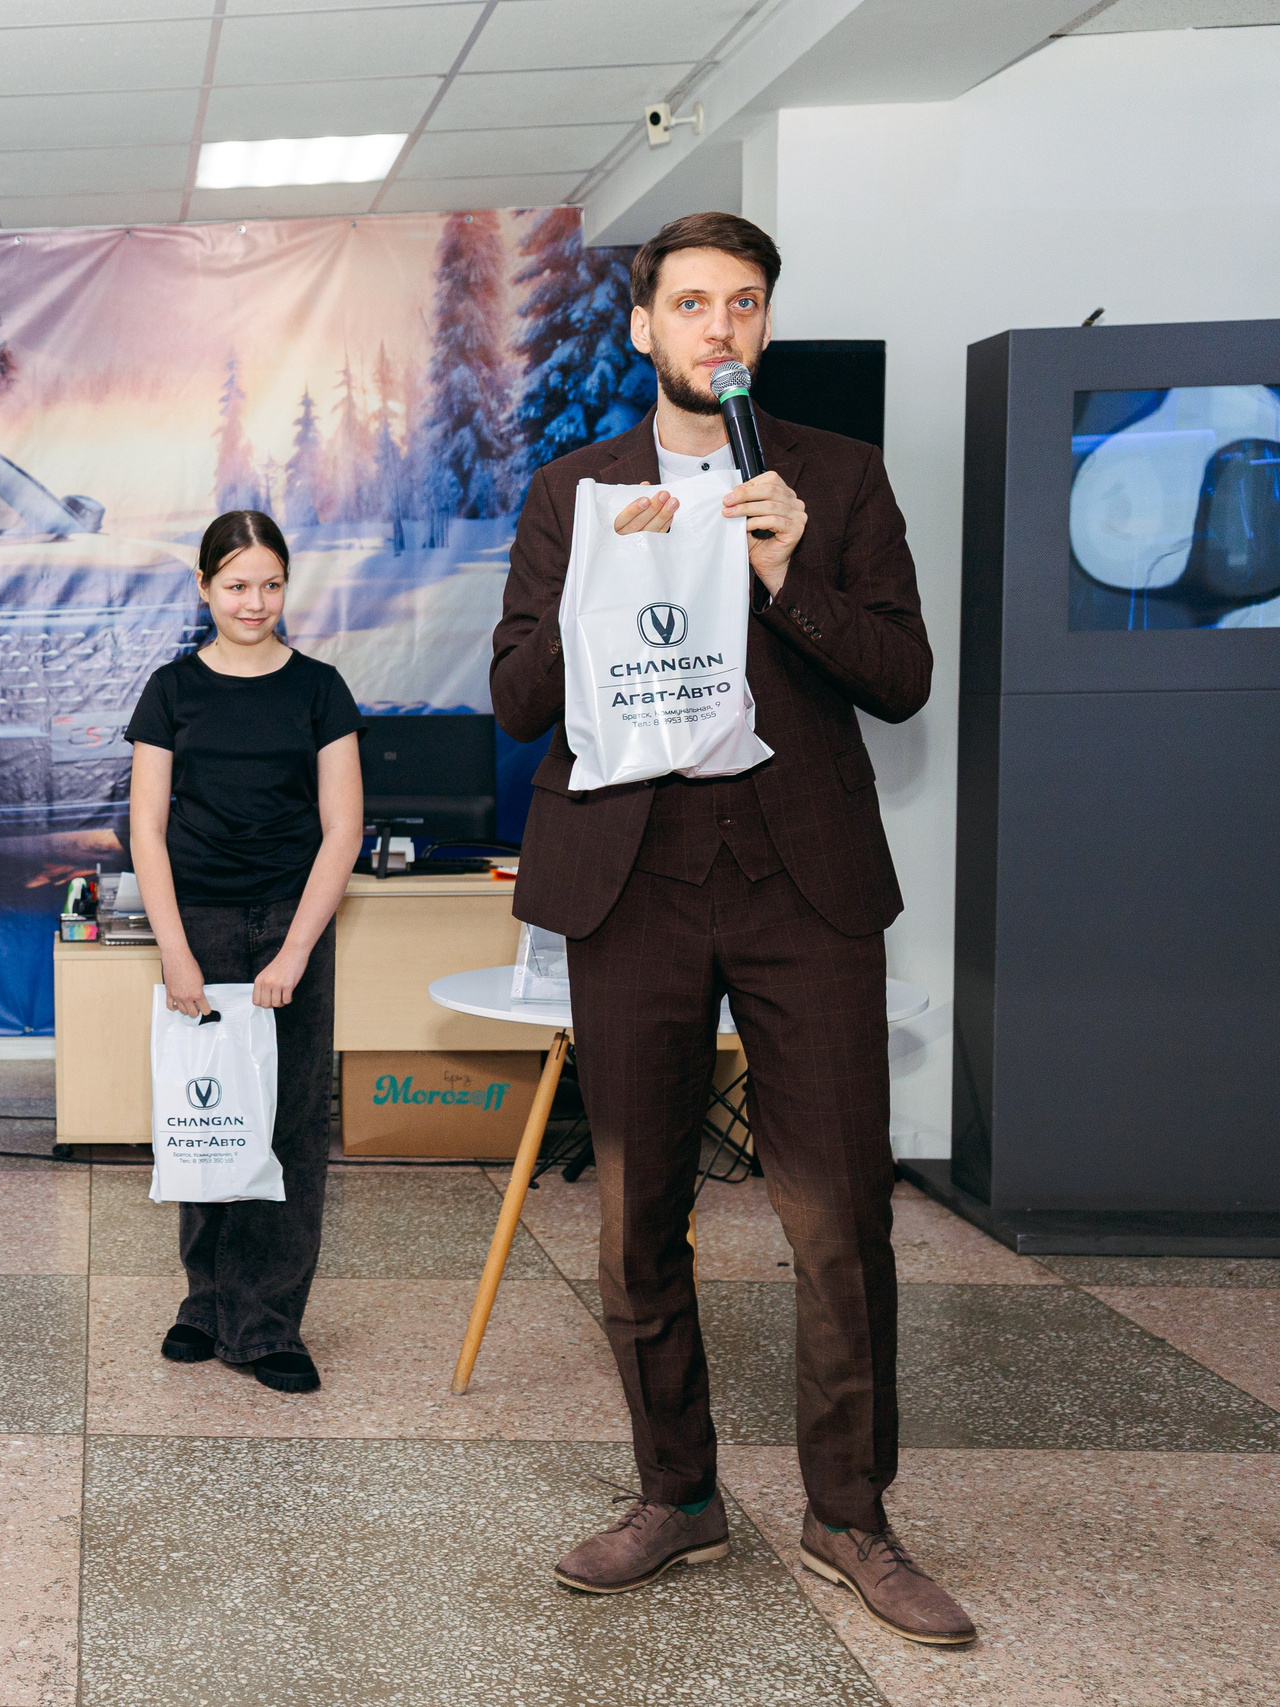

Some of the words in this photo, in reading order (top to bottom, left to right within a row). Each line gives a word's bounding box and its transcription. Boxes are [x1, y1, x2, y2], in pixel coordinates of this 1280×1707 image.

[609, 652, 724, 678] CHANGAN
[611, 681, 731, 708] Агат-Авто
[684, 714, 699, 723] 350
[700, 710, 717, 721] 555
[372, 1074, 511, 1112] Morozoff
[167, 1116, 244, 1127] CHANGAN
[167, 1136, 246, 1148] Агат-Авто
